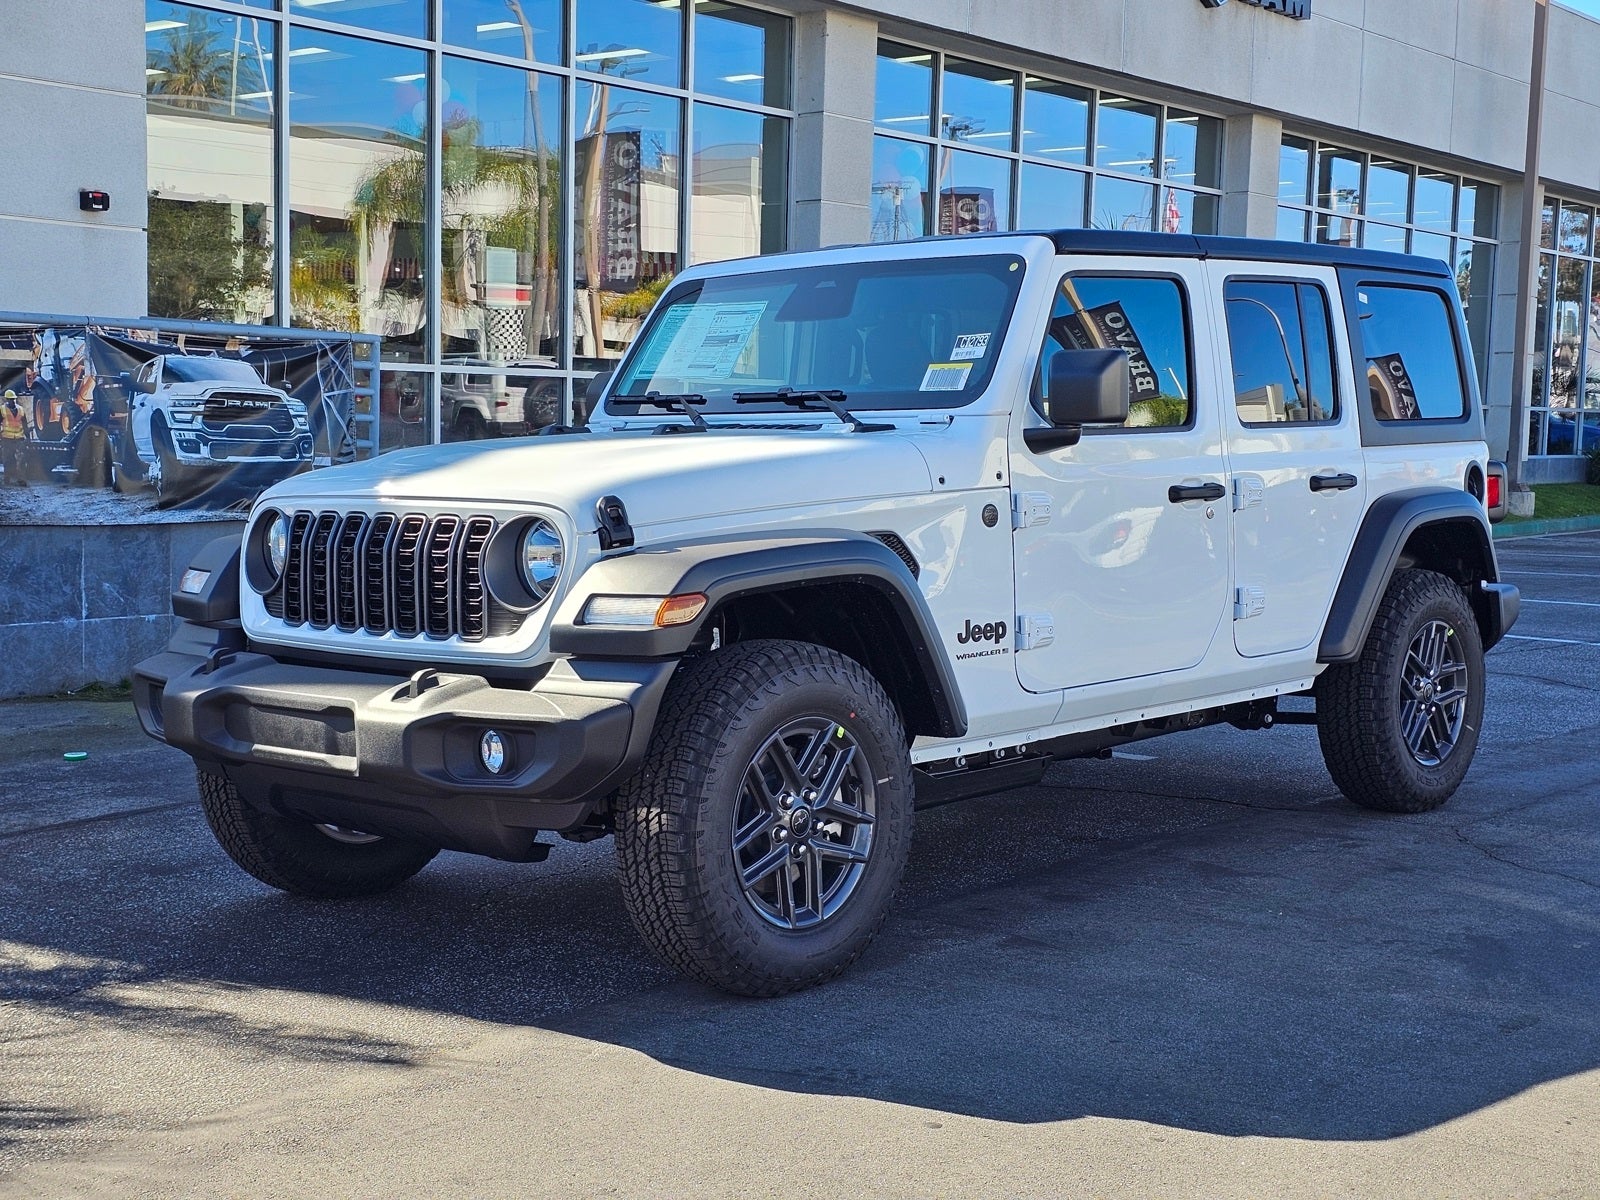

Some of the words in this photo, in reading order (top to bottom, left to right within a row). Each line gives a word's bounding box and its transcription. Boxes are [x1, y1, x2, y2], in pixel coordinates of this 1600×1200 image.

[227, 399, 268, 408] RAM
[957, 619, 1007, 644] Jeep
[956, 649, 1001, 660] WRANGLER
